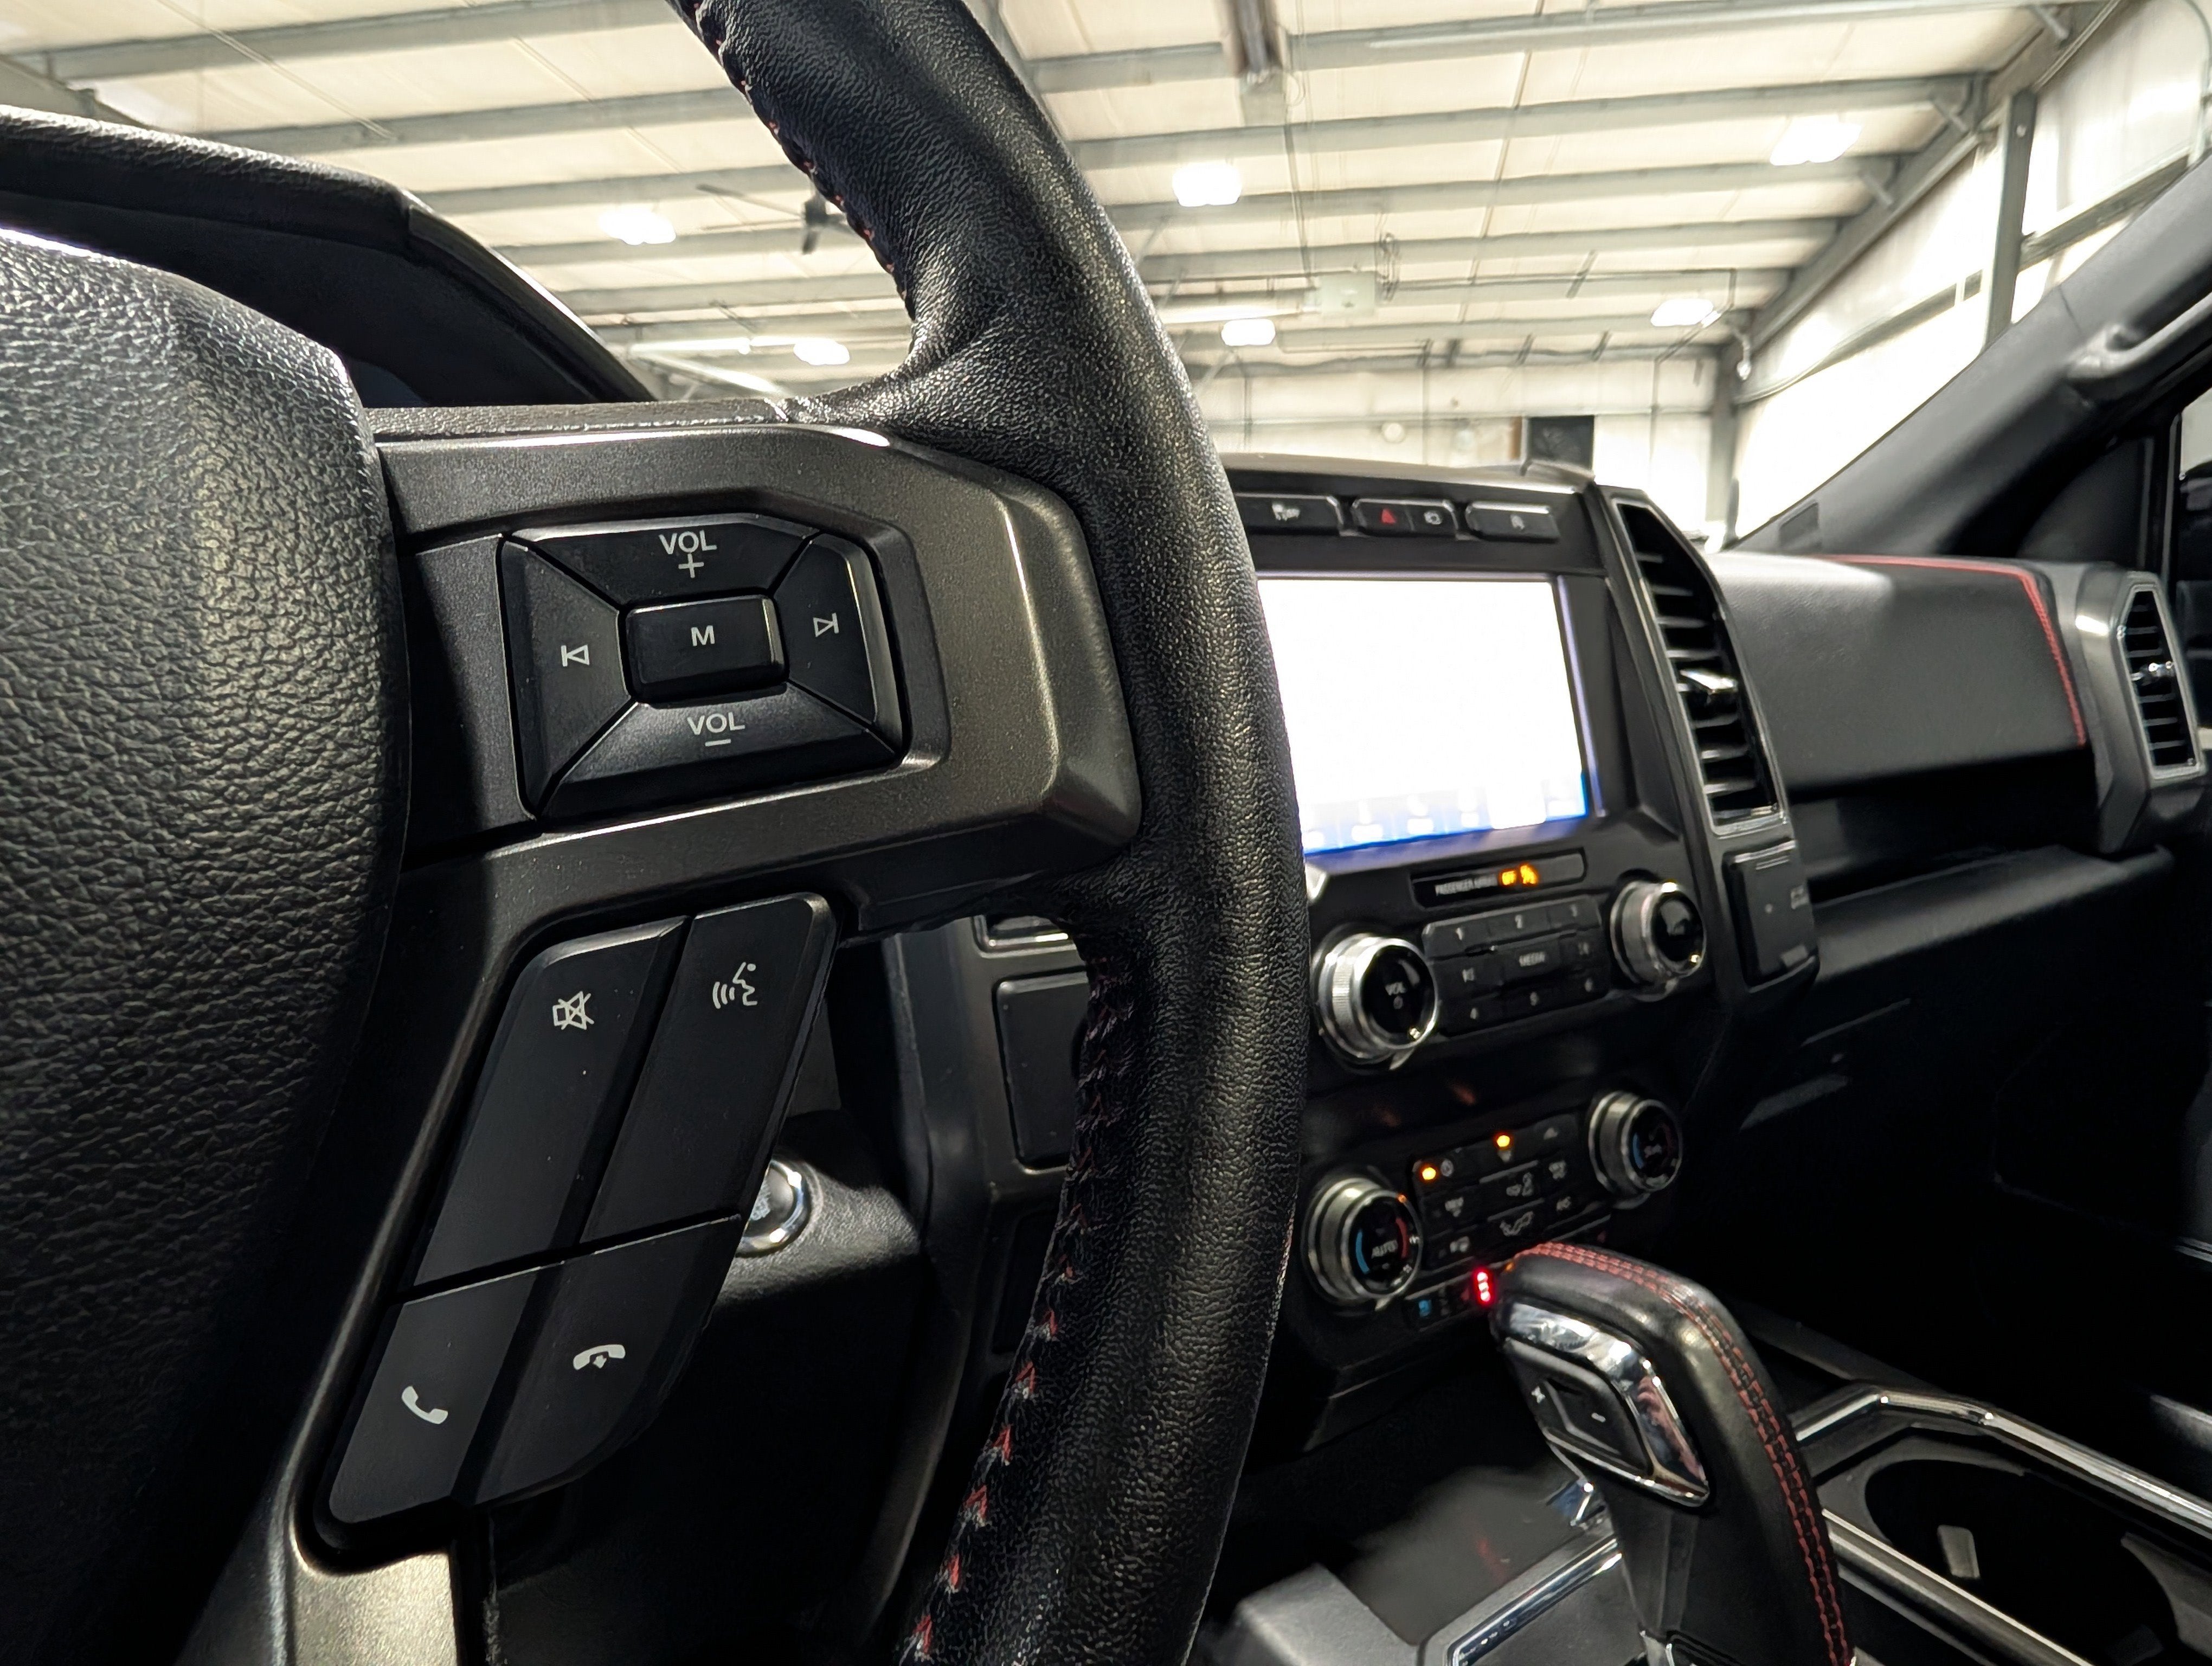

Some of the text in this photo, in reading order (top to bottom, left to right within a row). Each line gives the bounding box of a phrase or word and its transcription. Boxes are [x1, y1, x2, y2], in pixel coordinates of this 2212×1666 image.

[659, 530, 717, 555] VOL
[691, 625, 715, 646] M
[687, 712, 745, 735] VOL
[1385, 982, 1406, 996] VOL
[1371, 1239, 1399, 1259] AUTO
